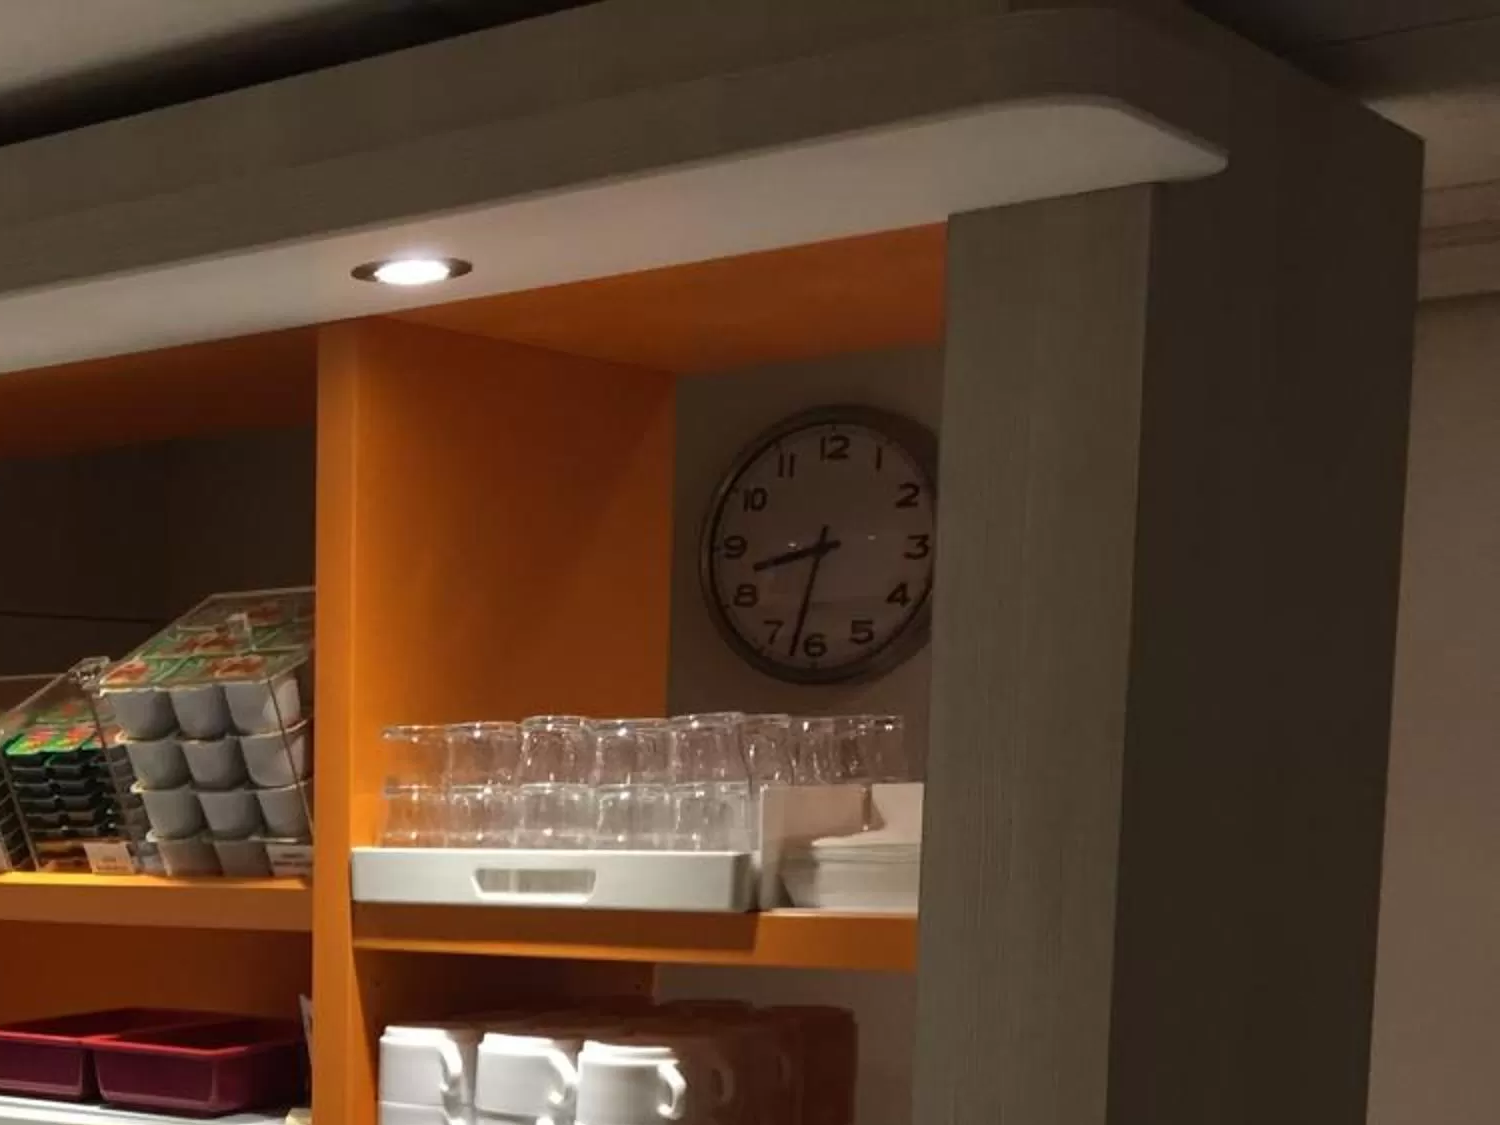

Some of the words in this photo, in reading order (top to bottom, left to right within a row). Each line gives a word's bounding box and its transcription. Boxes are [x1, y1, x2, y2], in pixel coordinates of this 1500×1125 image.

[820, 436, 850, 461] 12
[873, 447, 883, 471] 1
[777, 453, 796, 478] 11
[743, 488, 769, 512] 10
[895, 483, 920, 508] 2
[723, 535, 748, 559] 9
[903, 534, 930, 560] 3
[733, 584, 759, 608] 8
[885, 583, 911, 607] 4
[763, 620, 784, 645] 7
[850, 620, 875, 644] 5
[803, 633, 828, 657] 6
